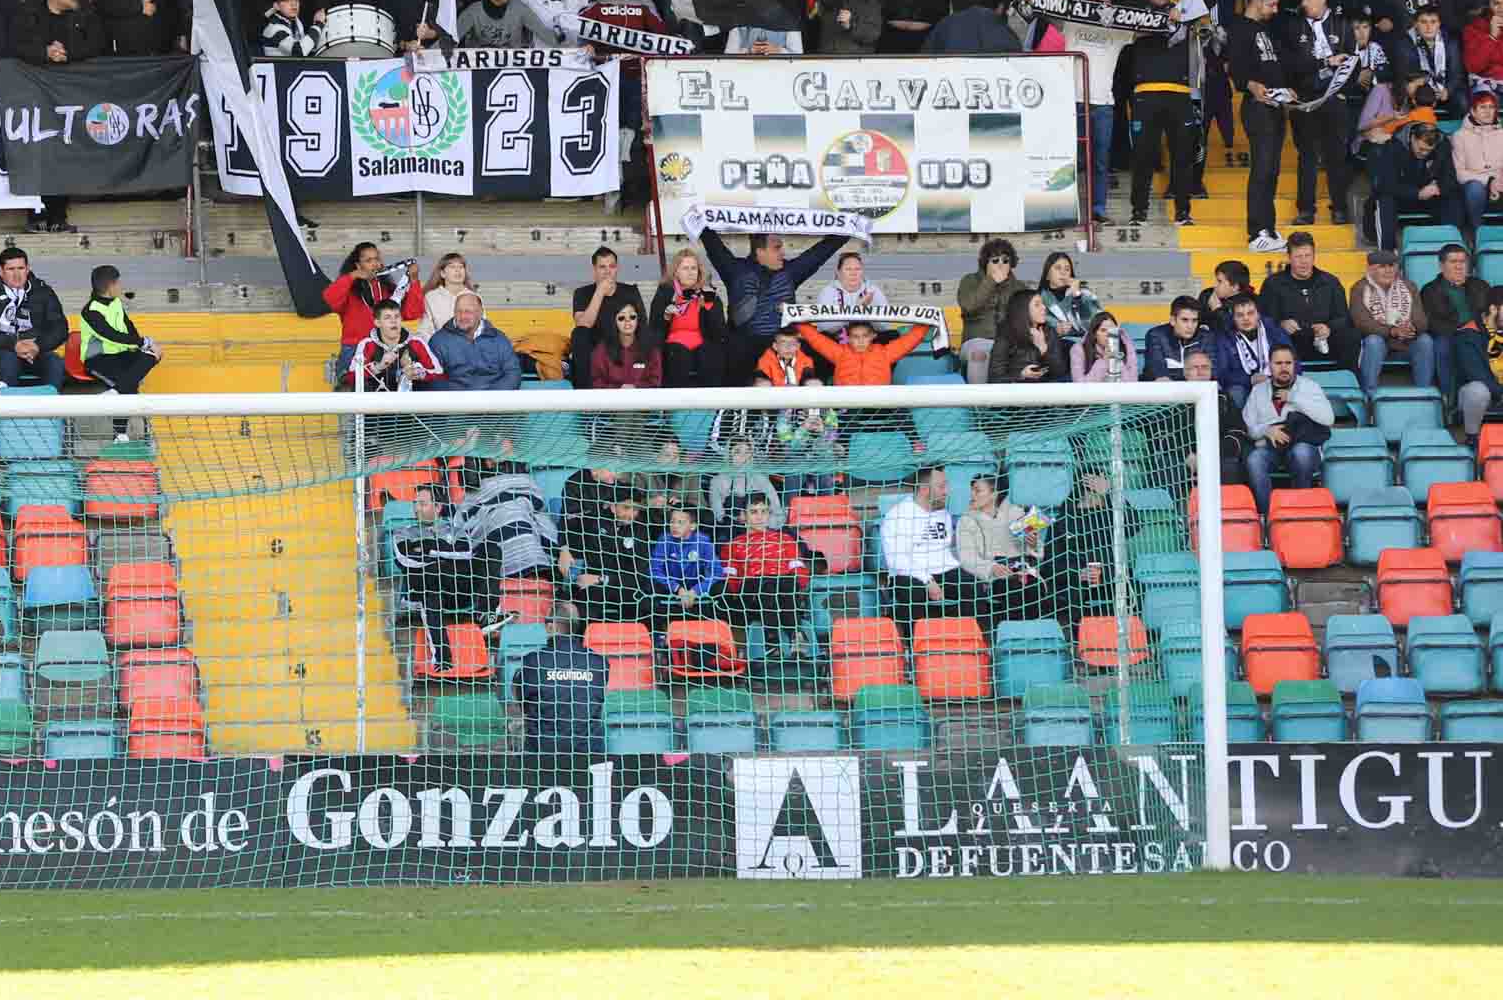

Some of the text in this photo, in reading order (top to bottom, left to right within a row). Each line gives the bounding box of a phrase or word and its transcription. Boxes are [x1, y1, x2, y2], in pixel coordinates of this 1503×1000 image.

[600, 5, 642, 16] adidas
[579, 19, 691, 55] TARUSOS
[358, 154, 466, 179] Salamanca
[720, 155, 813, 189] PEÑA
[917, 159, 992, 188] UDS
[705, 208, 846, 228] SALAMANCA UDS
[787, 303, 943, 320] CF SALMANTINO UDS
[546, 670, 594, 683] SEGURIDAD
[180, 792, 251, 853] de
[285, 762, 674, 851] Gonzalo
